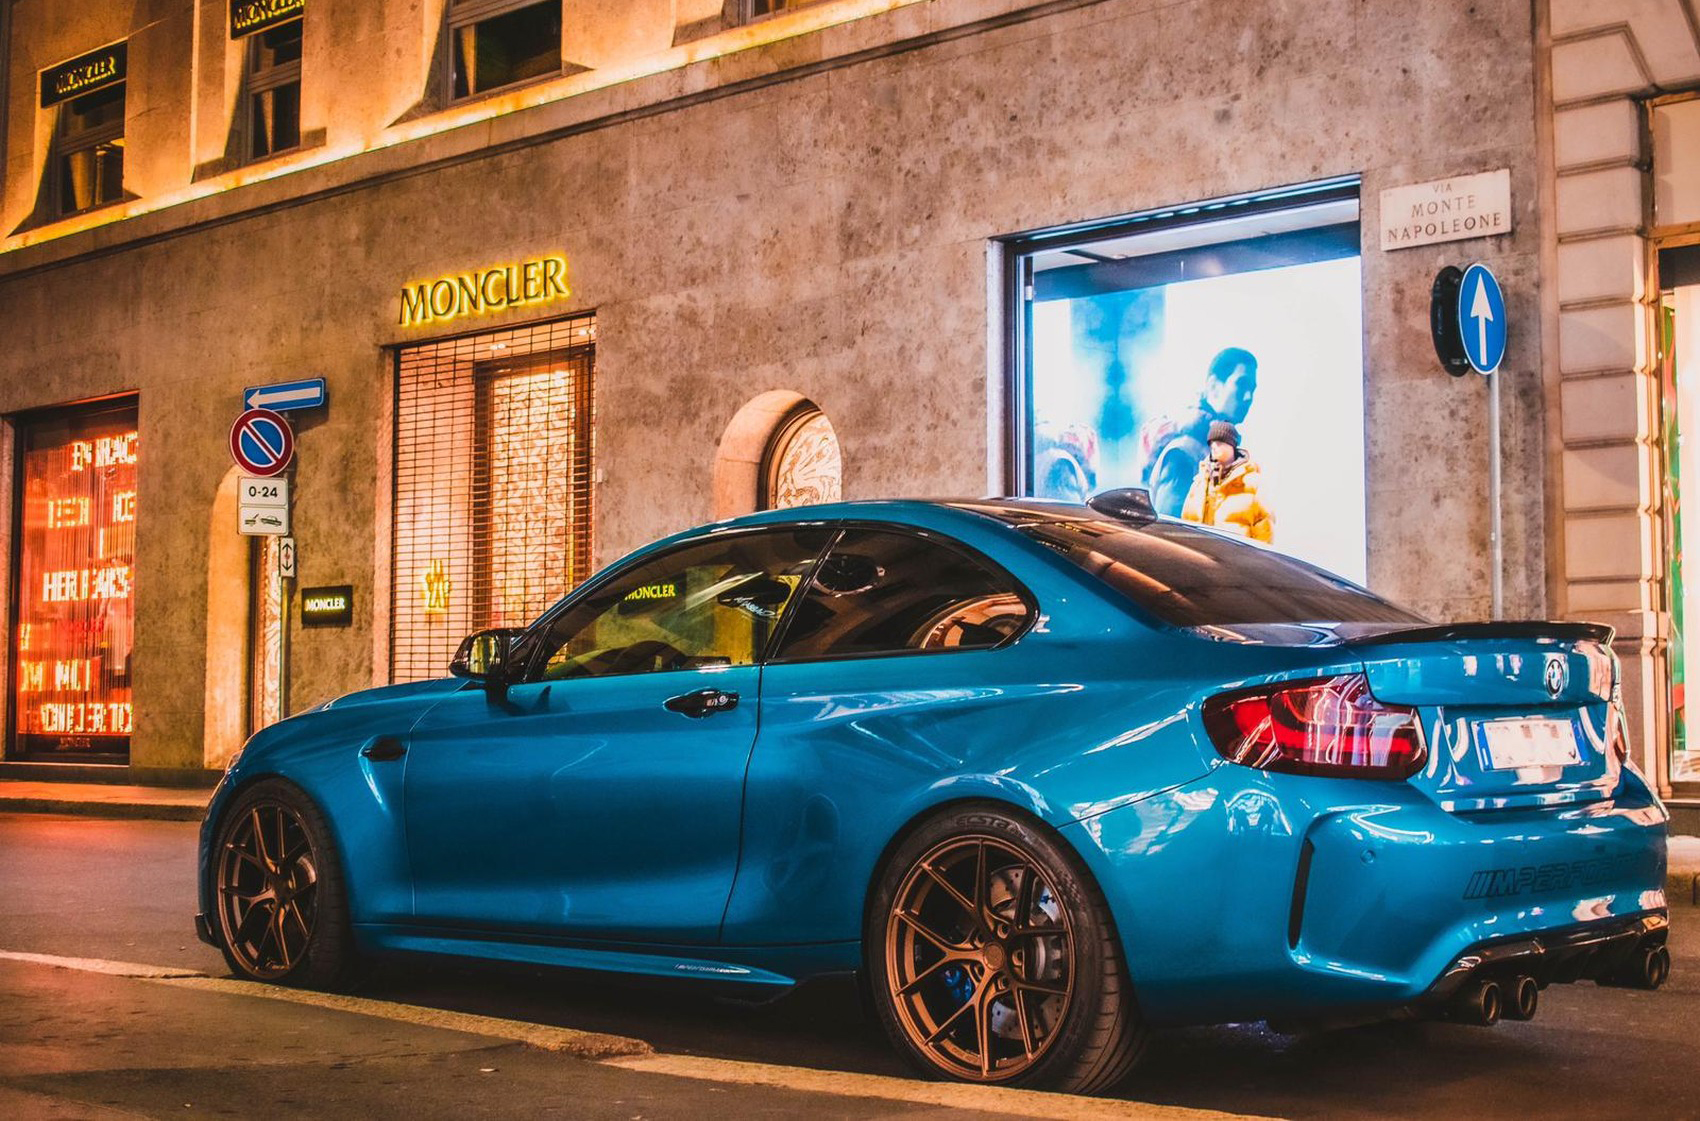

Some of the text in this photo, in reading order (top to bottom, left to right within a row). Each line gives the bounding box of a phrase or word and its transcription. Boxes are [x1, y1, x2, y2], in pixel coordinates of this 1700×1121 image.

[233, 0, 306, 29] MONCL
[1432, 183, 1453, 193] VIA
[1411, 194, 1476, 218] MONTE
[1387, 212, 1502, 243] NAPOLEONE
[398, 256, 570, 325] MONCLER
[248, 486, 278, 498] 0-24
[304, 597, 346, 611] MONCLER
